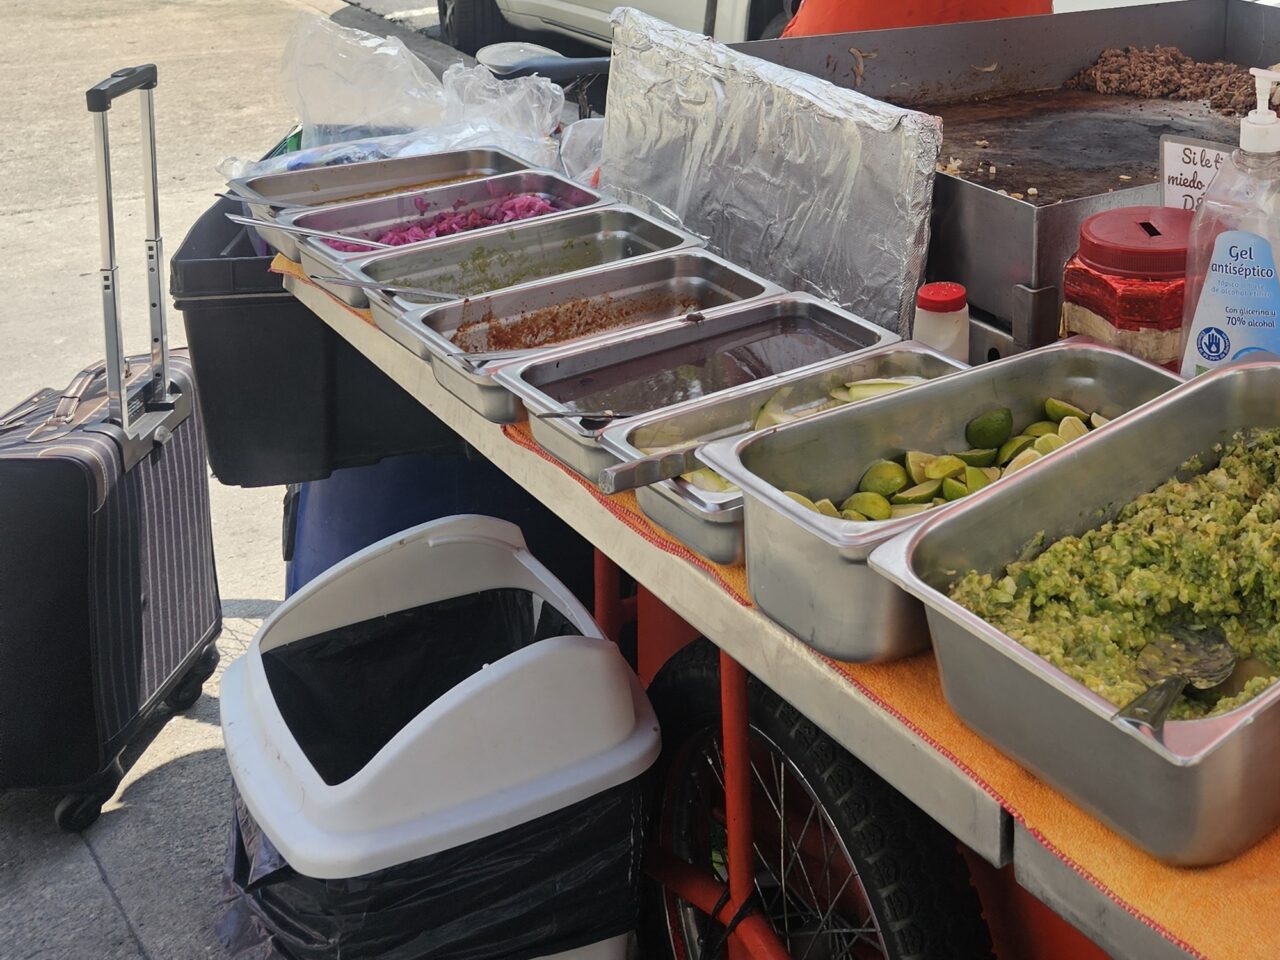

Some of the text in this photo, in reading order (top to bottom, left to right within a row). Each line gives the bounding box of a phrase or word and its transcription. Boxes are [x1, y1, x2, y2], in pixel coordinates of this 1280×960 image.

[1182, 147, 1198, 166] Si
[1200, 149, 1212, 168] le
[1168, 171, 1205, 190] miedo
[1229, 245, 1254, 262] Gel
[1211, 263, 1274, 279] antiséptico
[1225, 306, 1238, 314] Con
[1239, 307, 1270, 316] glicerina
[1226, 316, 1275, 328] 70% alcohol
